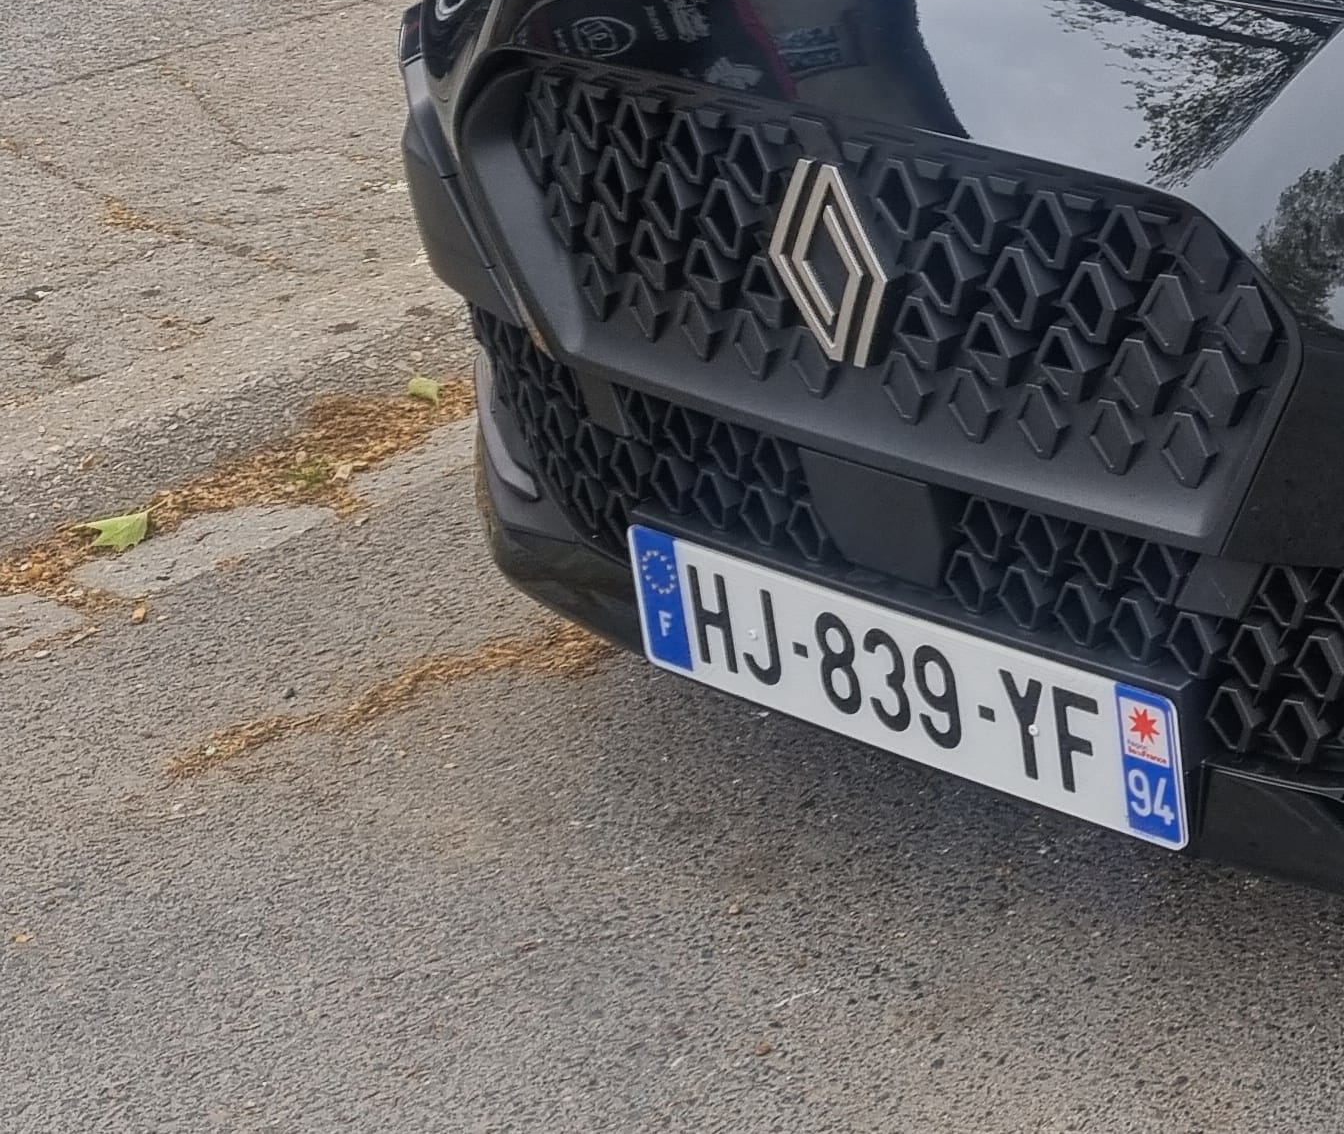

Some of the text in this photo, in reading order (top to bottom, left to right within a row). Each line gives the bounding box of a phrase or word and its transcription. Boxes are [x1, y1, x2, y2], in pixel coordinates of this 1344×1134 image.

[658, 610, 672, 638] F
[686, 564, 1099, 793] HJ-839-YF
[1128, 768, 1175, 826] 94
